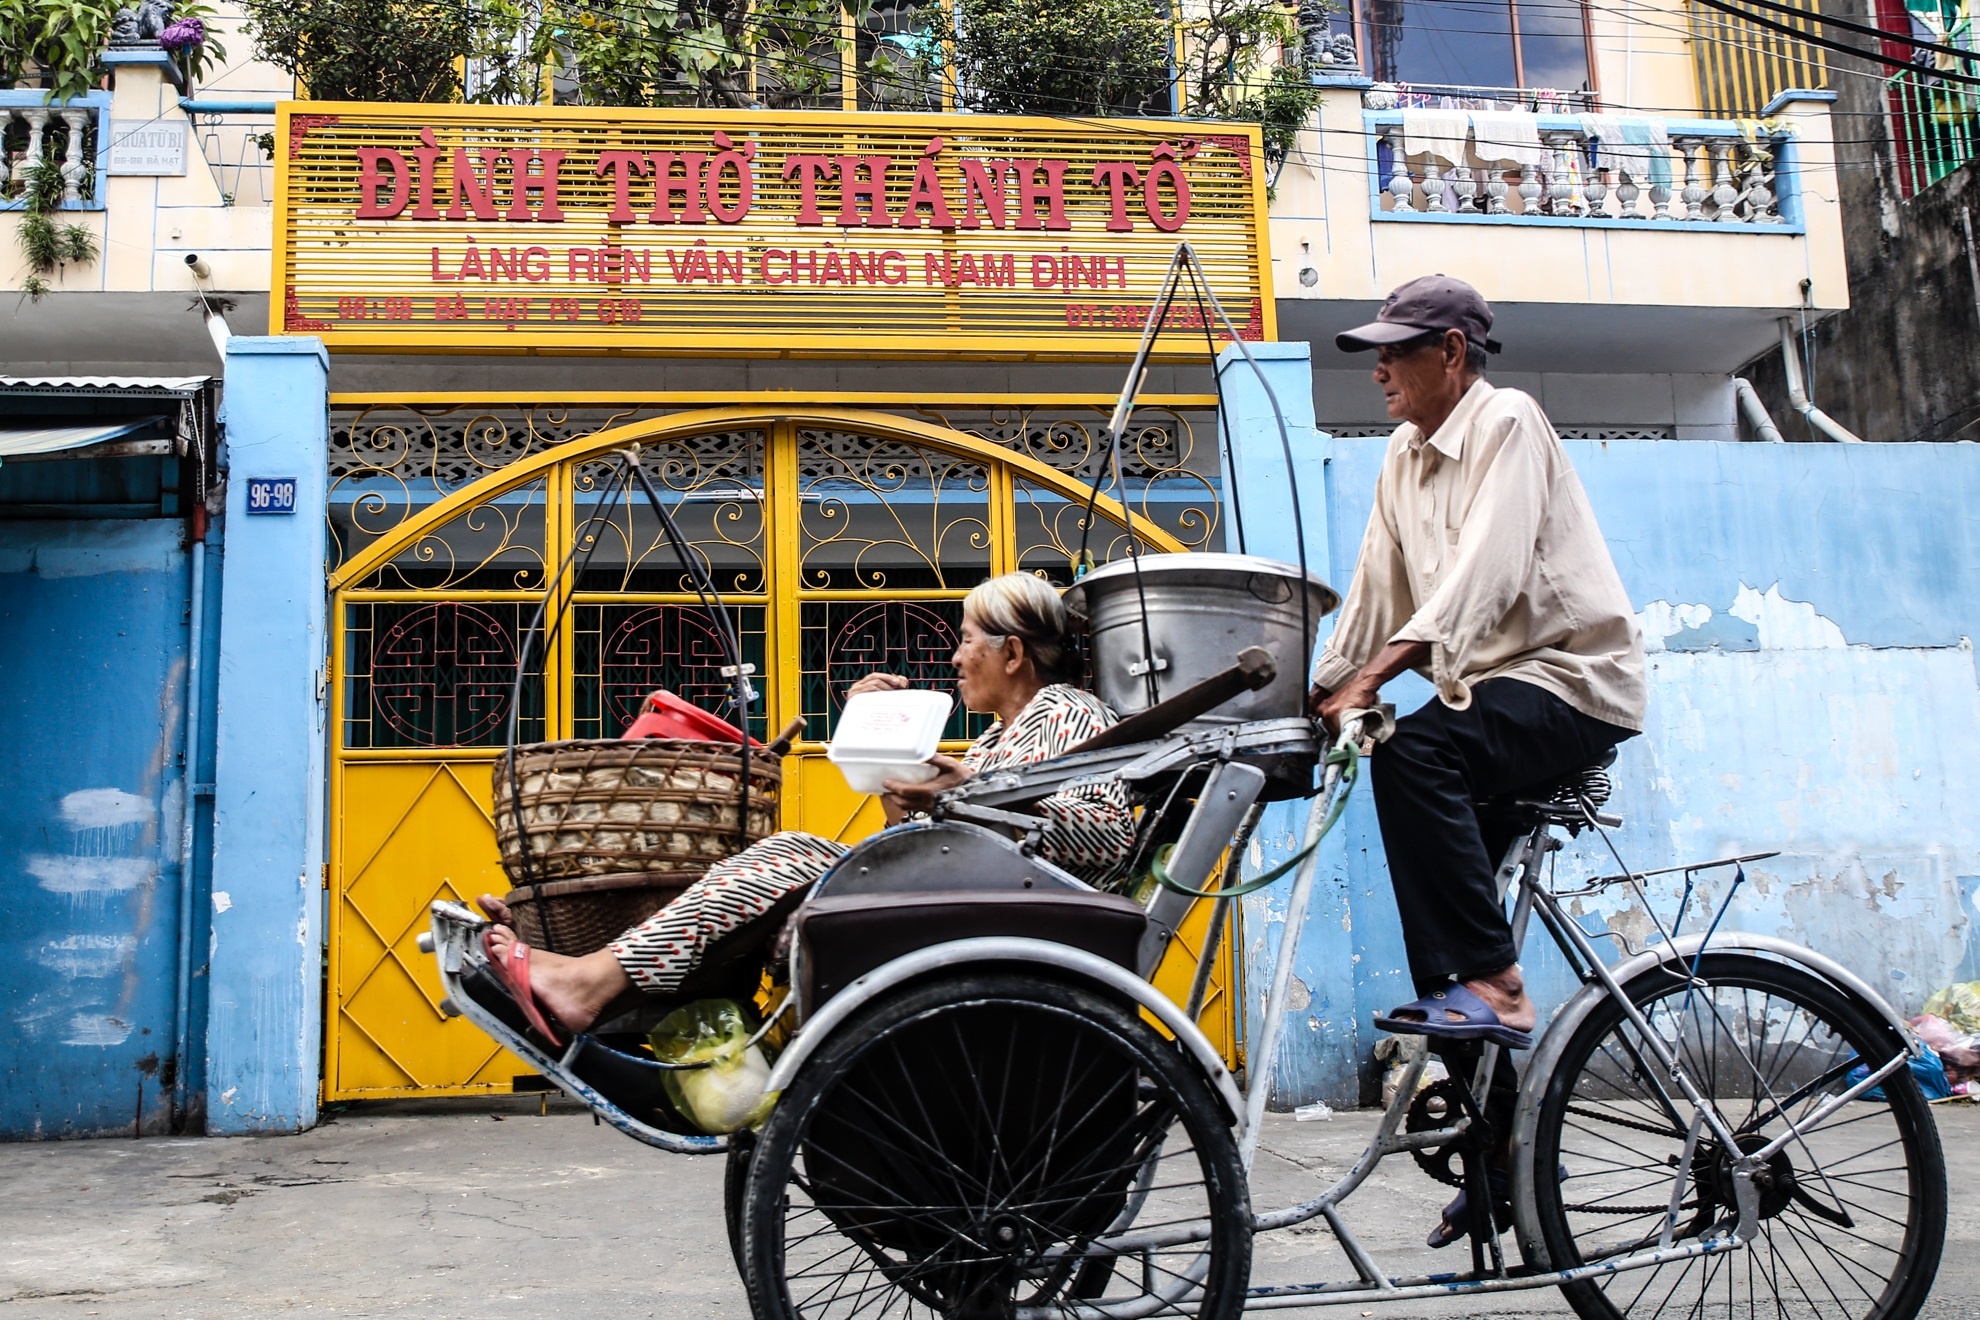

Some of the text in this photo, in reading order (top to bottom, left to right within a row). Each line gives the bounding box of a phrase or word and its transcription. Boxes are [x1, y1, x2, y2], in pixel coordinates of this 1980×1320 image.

[355, 126, 1201, 233] ĐÌNH THỜ THÁNH TỔ
[431, 235, 1127, 294] LÀNG RÈN VÂN CHÀNG NAM ĐỊNH
[338, 292, 642, 331] 96:98 BÀ HẠT P9 Q10
[251, 483, 293, 507] 96-98
